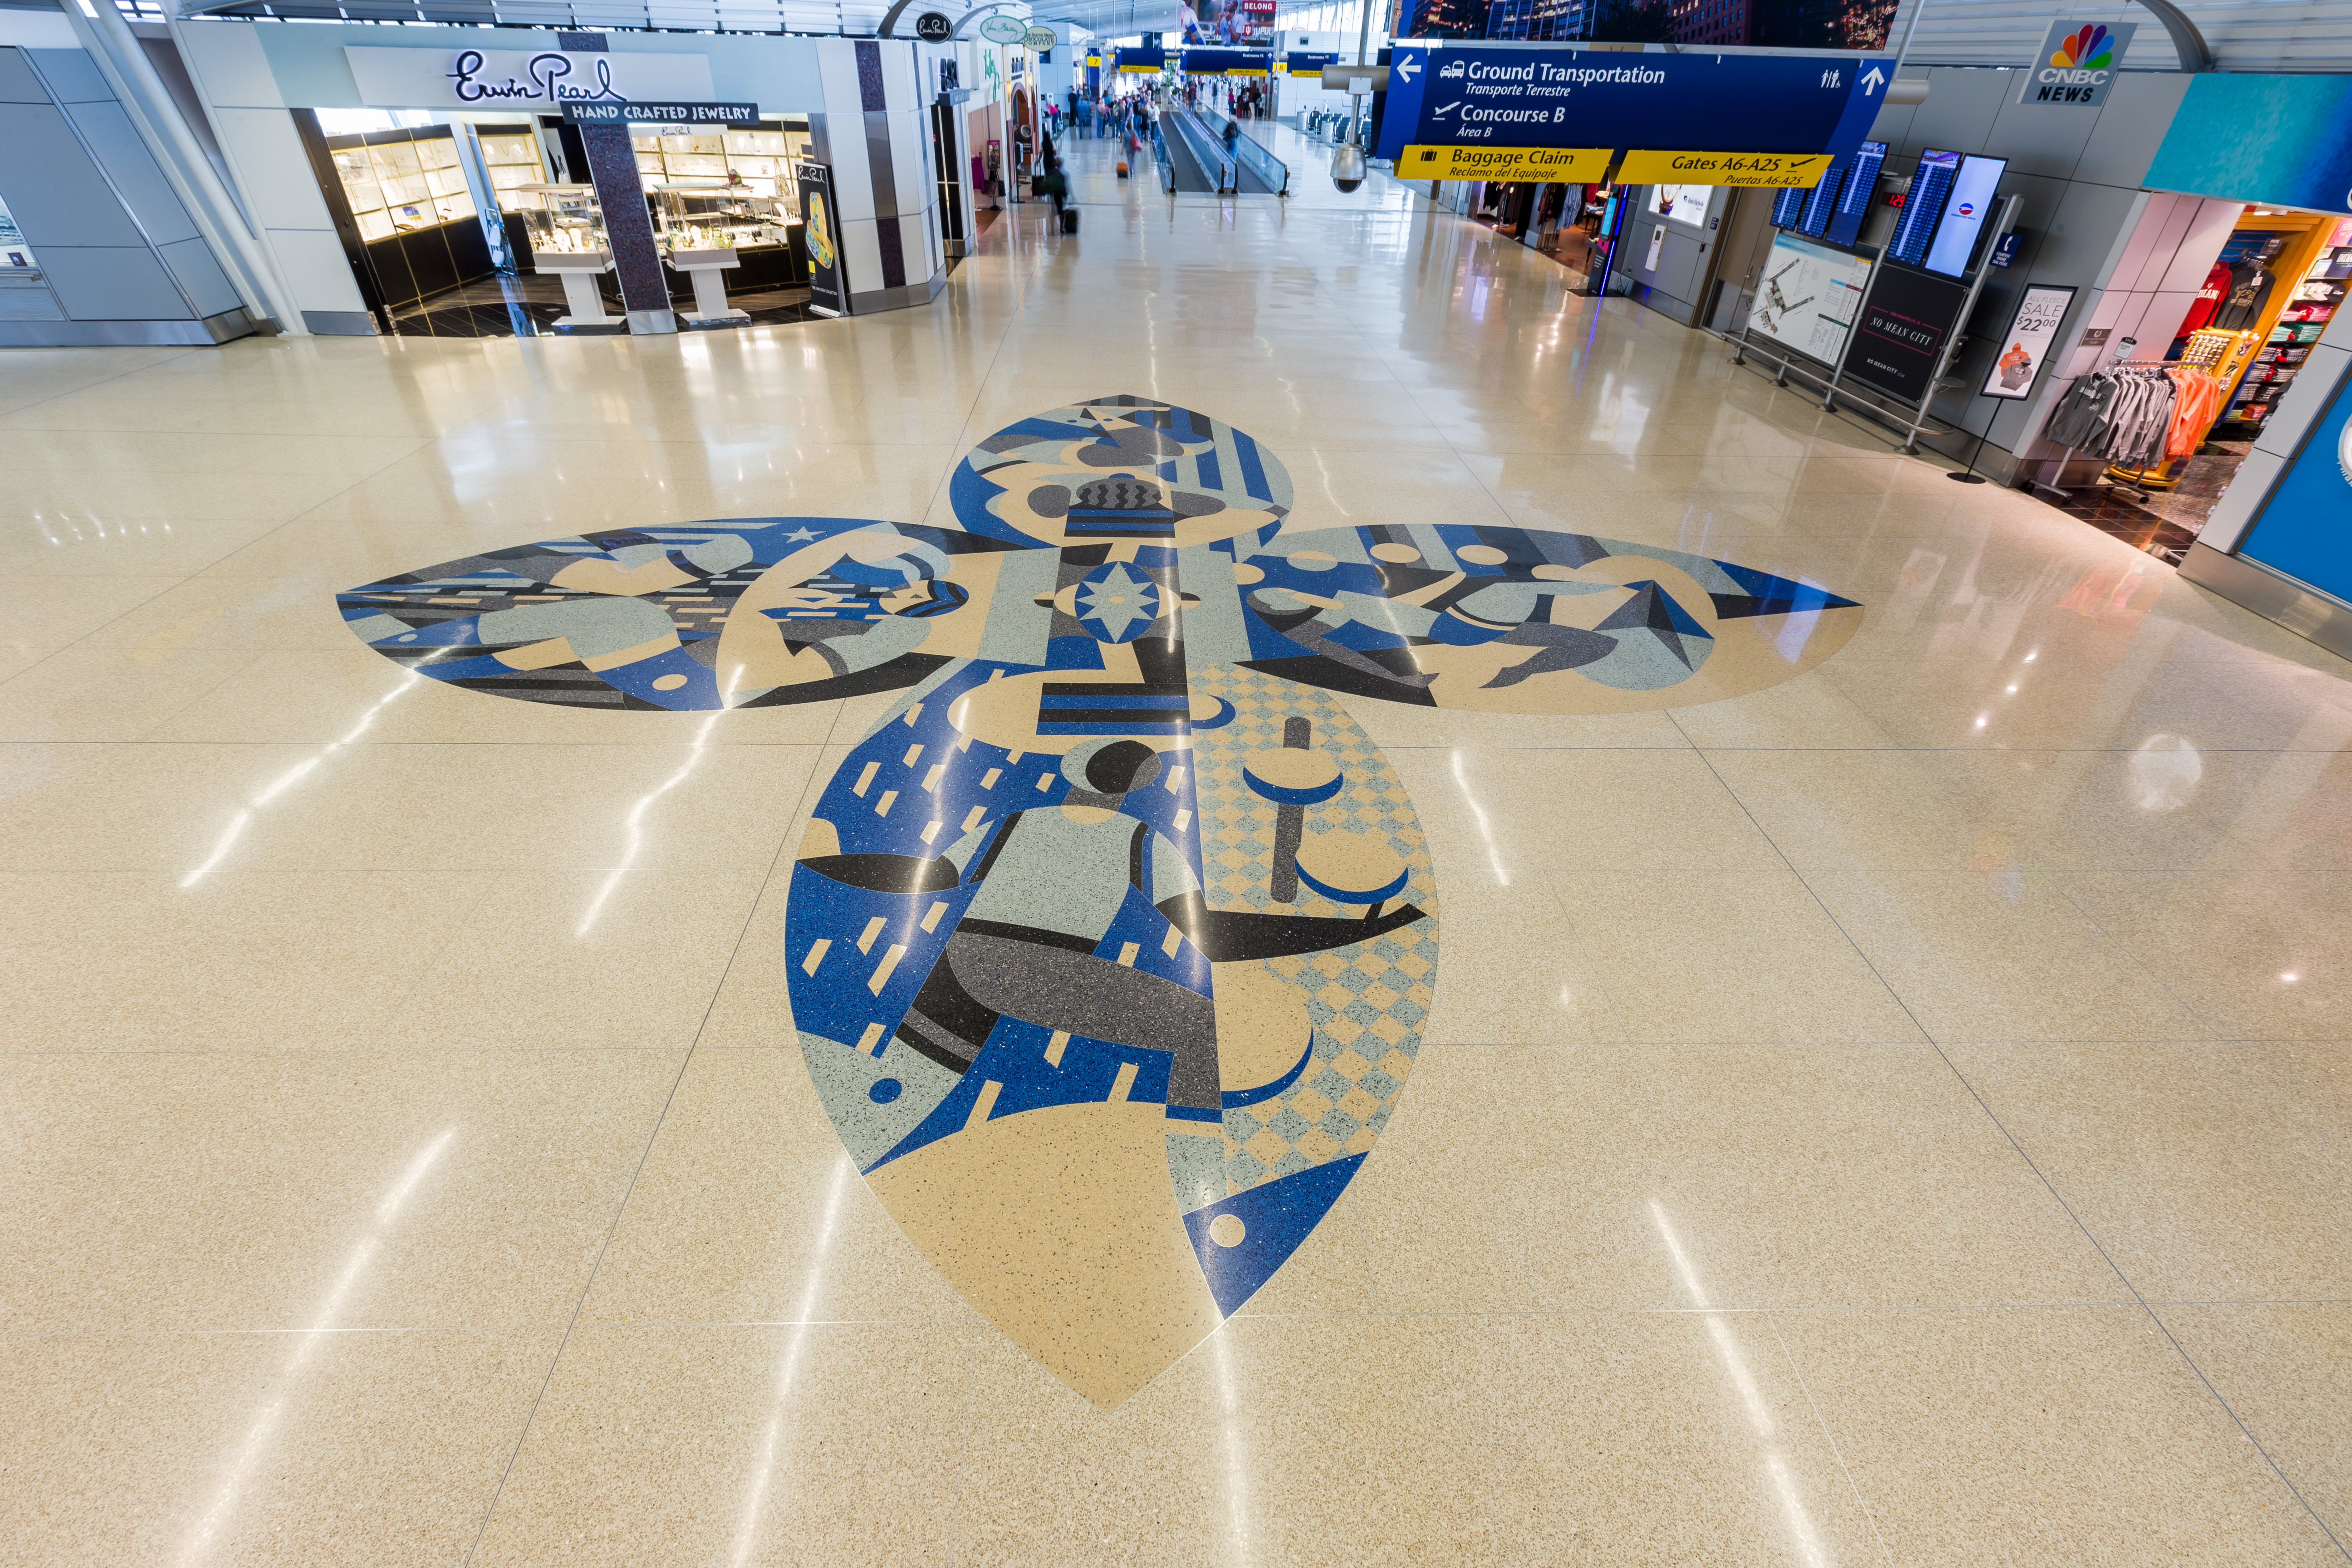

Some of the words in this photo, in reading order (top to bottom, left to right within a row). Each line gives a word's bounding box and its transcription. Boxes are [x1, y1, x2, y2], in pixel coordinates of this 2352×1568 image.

[919, 19, 934, 34] Erwin
[932, 20, 949, 34] Pearl
[445, 50, 543, 101] Erwin
[529, 54, 627, 102] Pearl
[1469, 62, 1534, 80] Ground
[1540, 63, 1665, 87] Transportation
[2038, 68, 2109, 85] CNBC
[1465, 82, 1523, 98] Transporte
[1526, 84, 1571, 97] Terrestre
[2037, 86, 2094, 103] NEWS
[572, 105, 619, 118] HAND
[623, 106, 688, 119] CRAFTED
[692, 107, 750, 120] JEWELRY
[1460, 104, 1549, 122] Concourse
[1553, 107, 1566, 122] B
[1456, 123, 1482, 137] Área
[1484, 127, 1493, 137] B
[1452, 149, 1524, 167] Baggage
[1529, 150, 1574, 165] Claim
[1671, 156, 1718, 170] Gates
[1720, 157, 1783, 172] A6-A25
[1449, 167, 1492, 177] Reclamo
[1495, 167, 1512, 177] del
[1513, 168, 1557, 180] Equipaje
[1724, 175, 1763, 185] Puertas
[1763, 176, 1804, 185] A6-A25
[2041, 296, 2066, 304] FLEECE
[2022, 303, 2063, 317] SALE
[1870, 317, 1882, 328] NO
[1883, 322, 1909, 337] MEAN
[1910, 331, 1933, 345] CITY
[1873, 361, 1887, 370] MEAN
[1886, 366, 1898, 374] CITY
